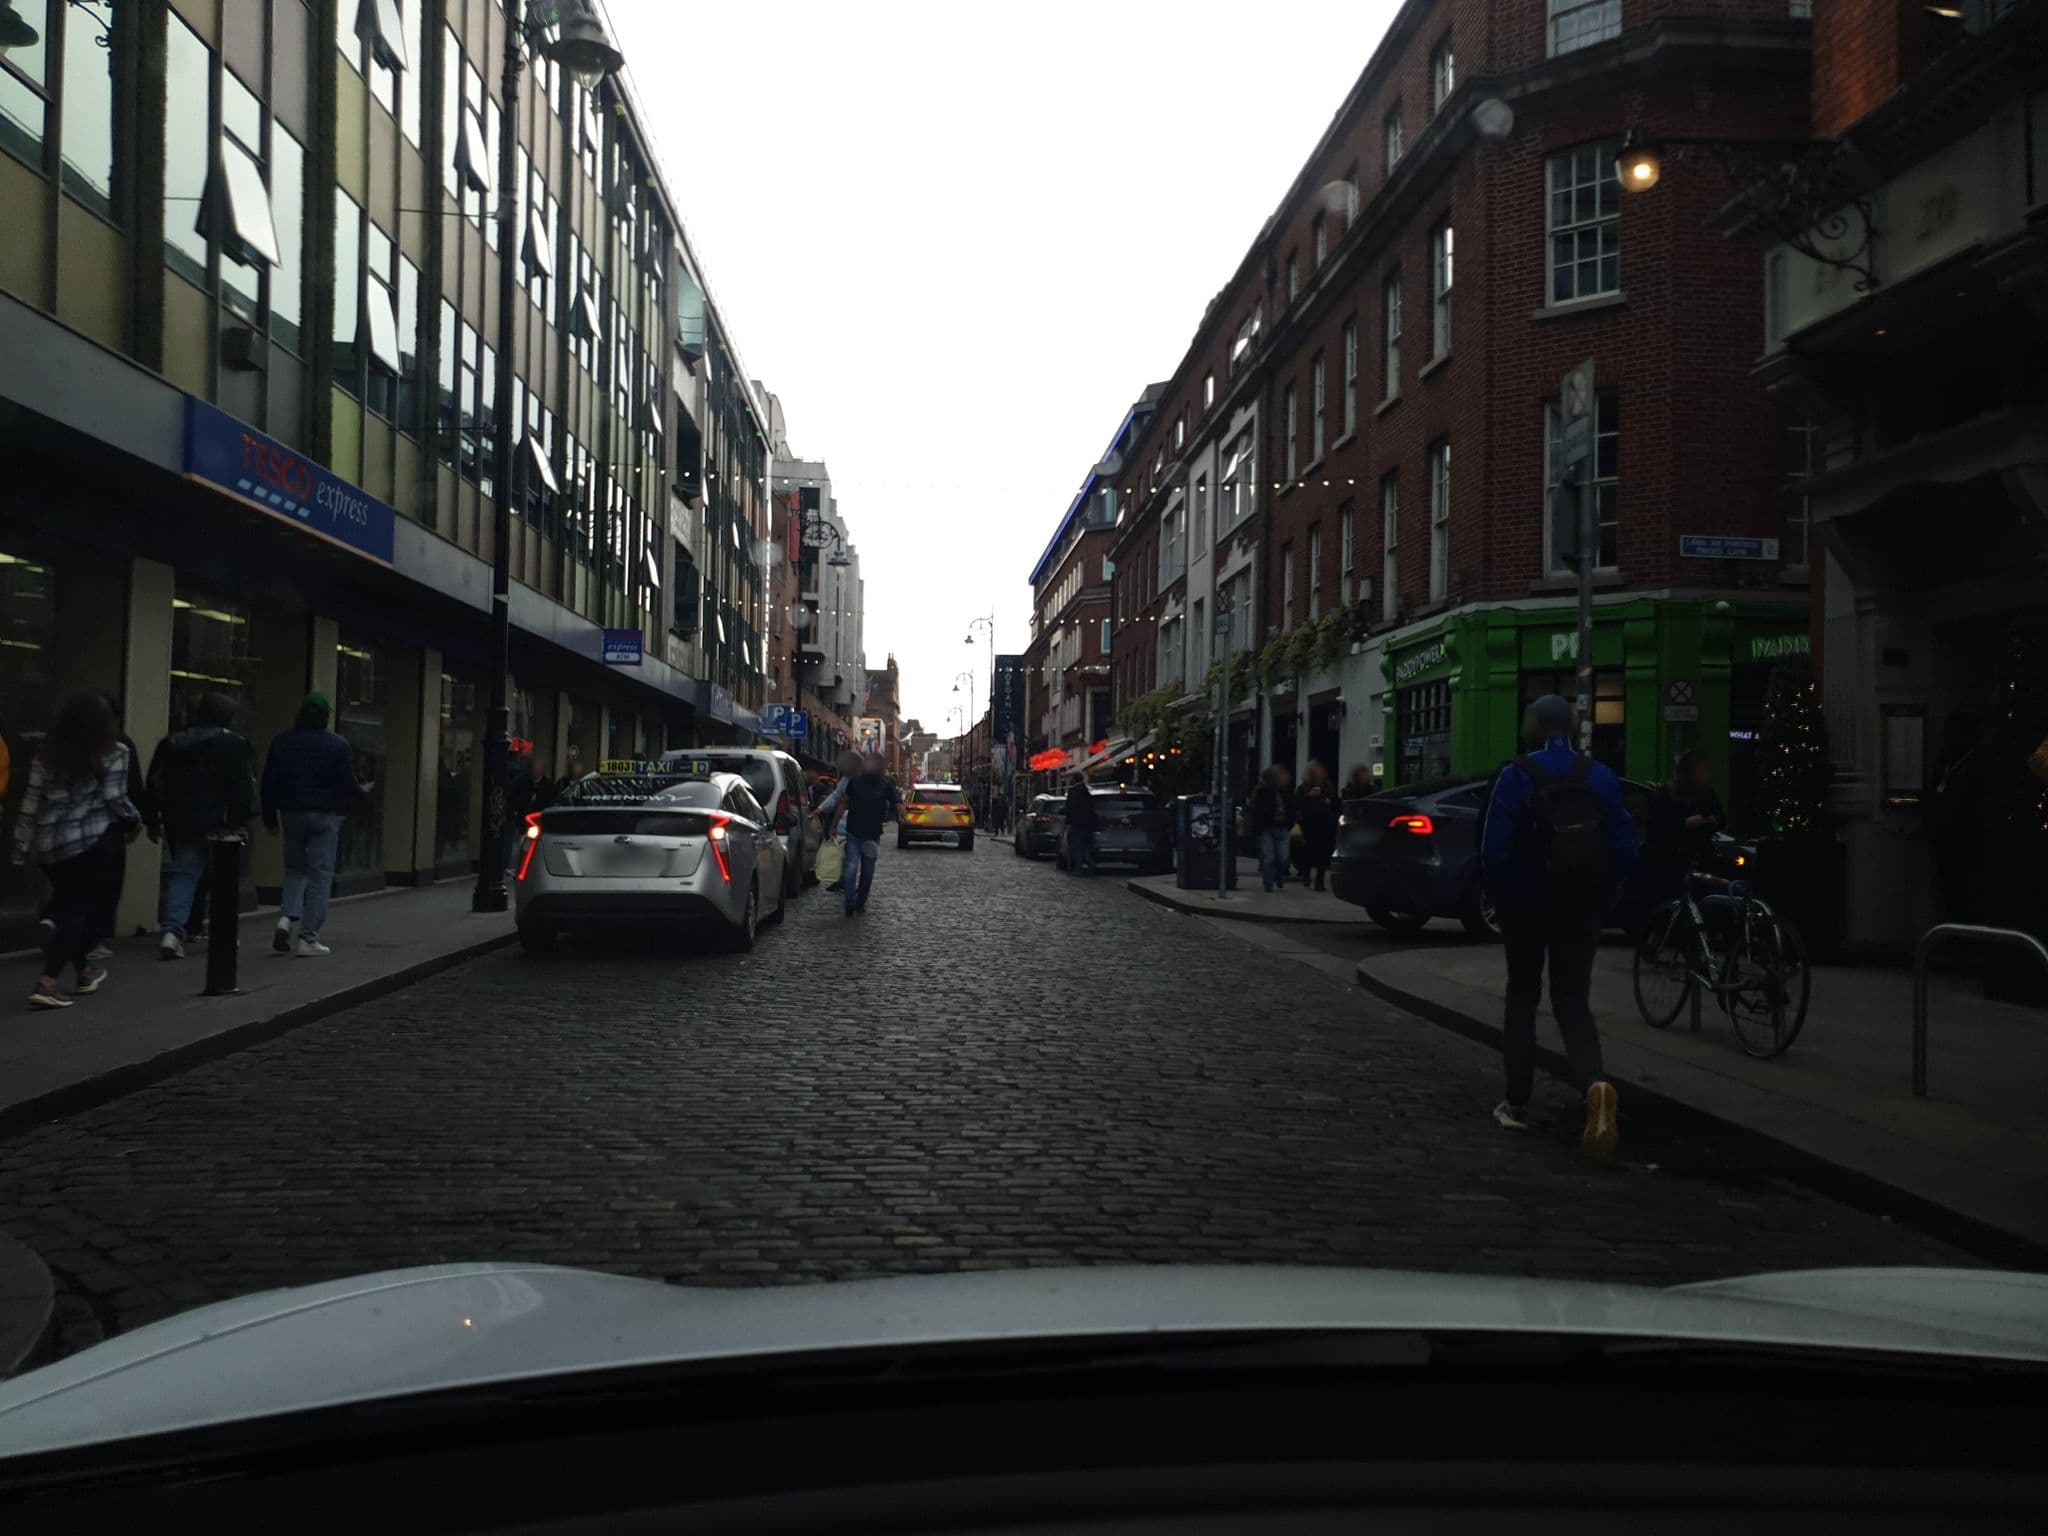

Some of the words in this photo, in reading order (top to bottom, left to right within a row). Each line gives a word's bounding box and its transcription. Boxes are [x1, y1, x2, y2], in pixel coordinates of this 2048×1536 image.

[239, 432, 314, 499] TESCO
[316, 480, 369, 526] express
[774, 706, 785, 718] P
[791, 713, 801, 727] P
[607, 761, 635, 772] 18031
[639, 760, 671, 772] TAXI
